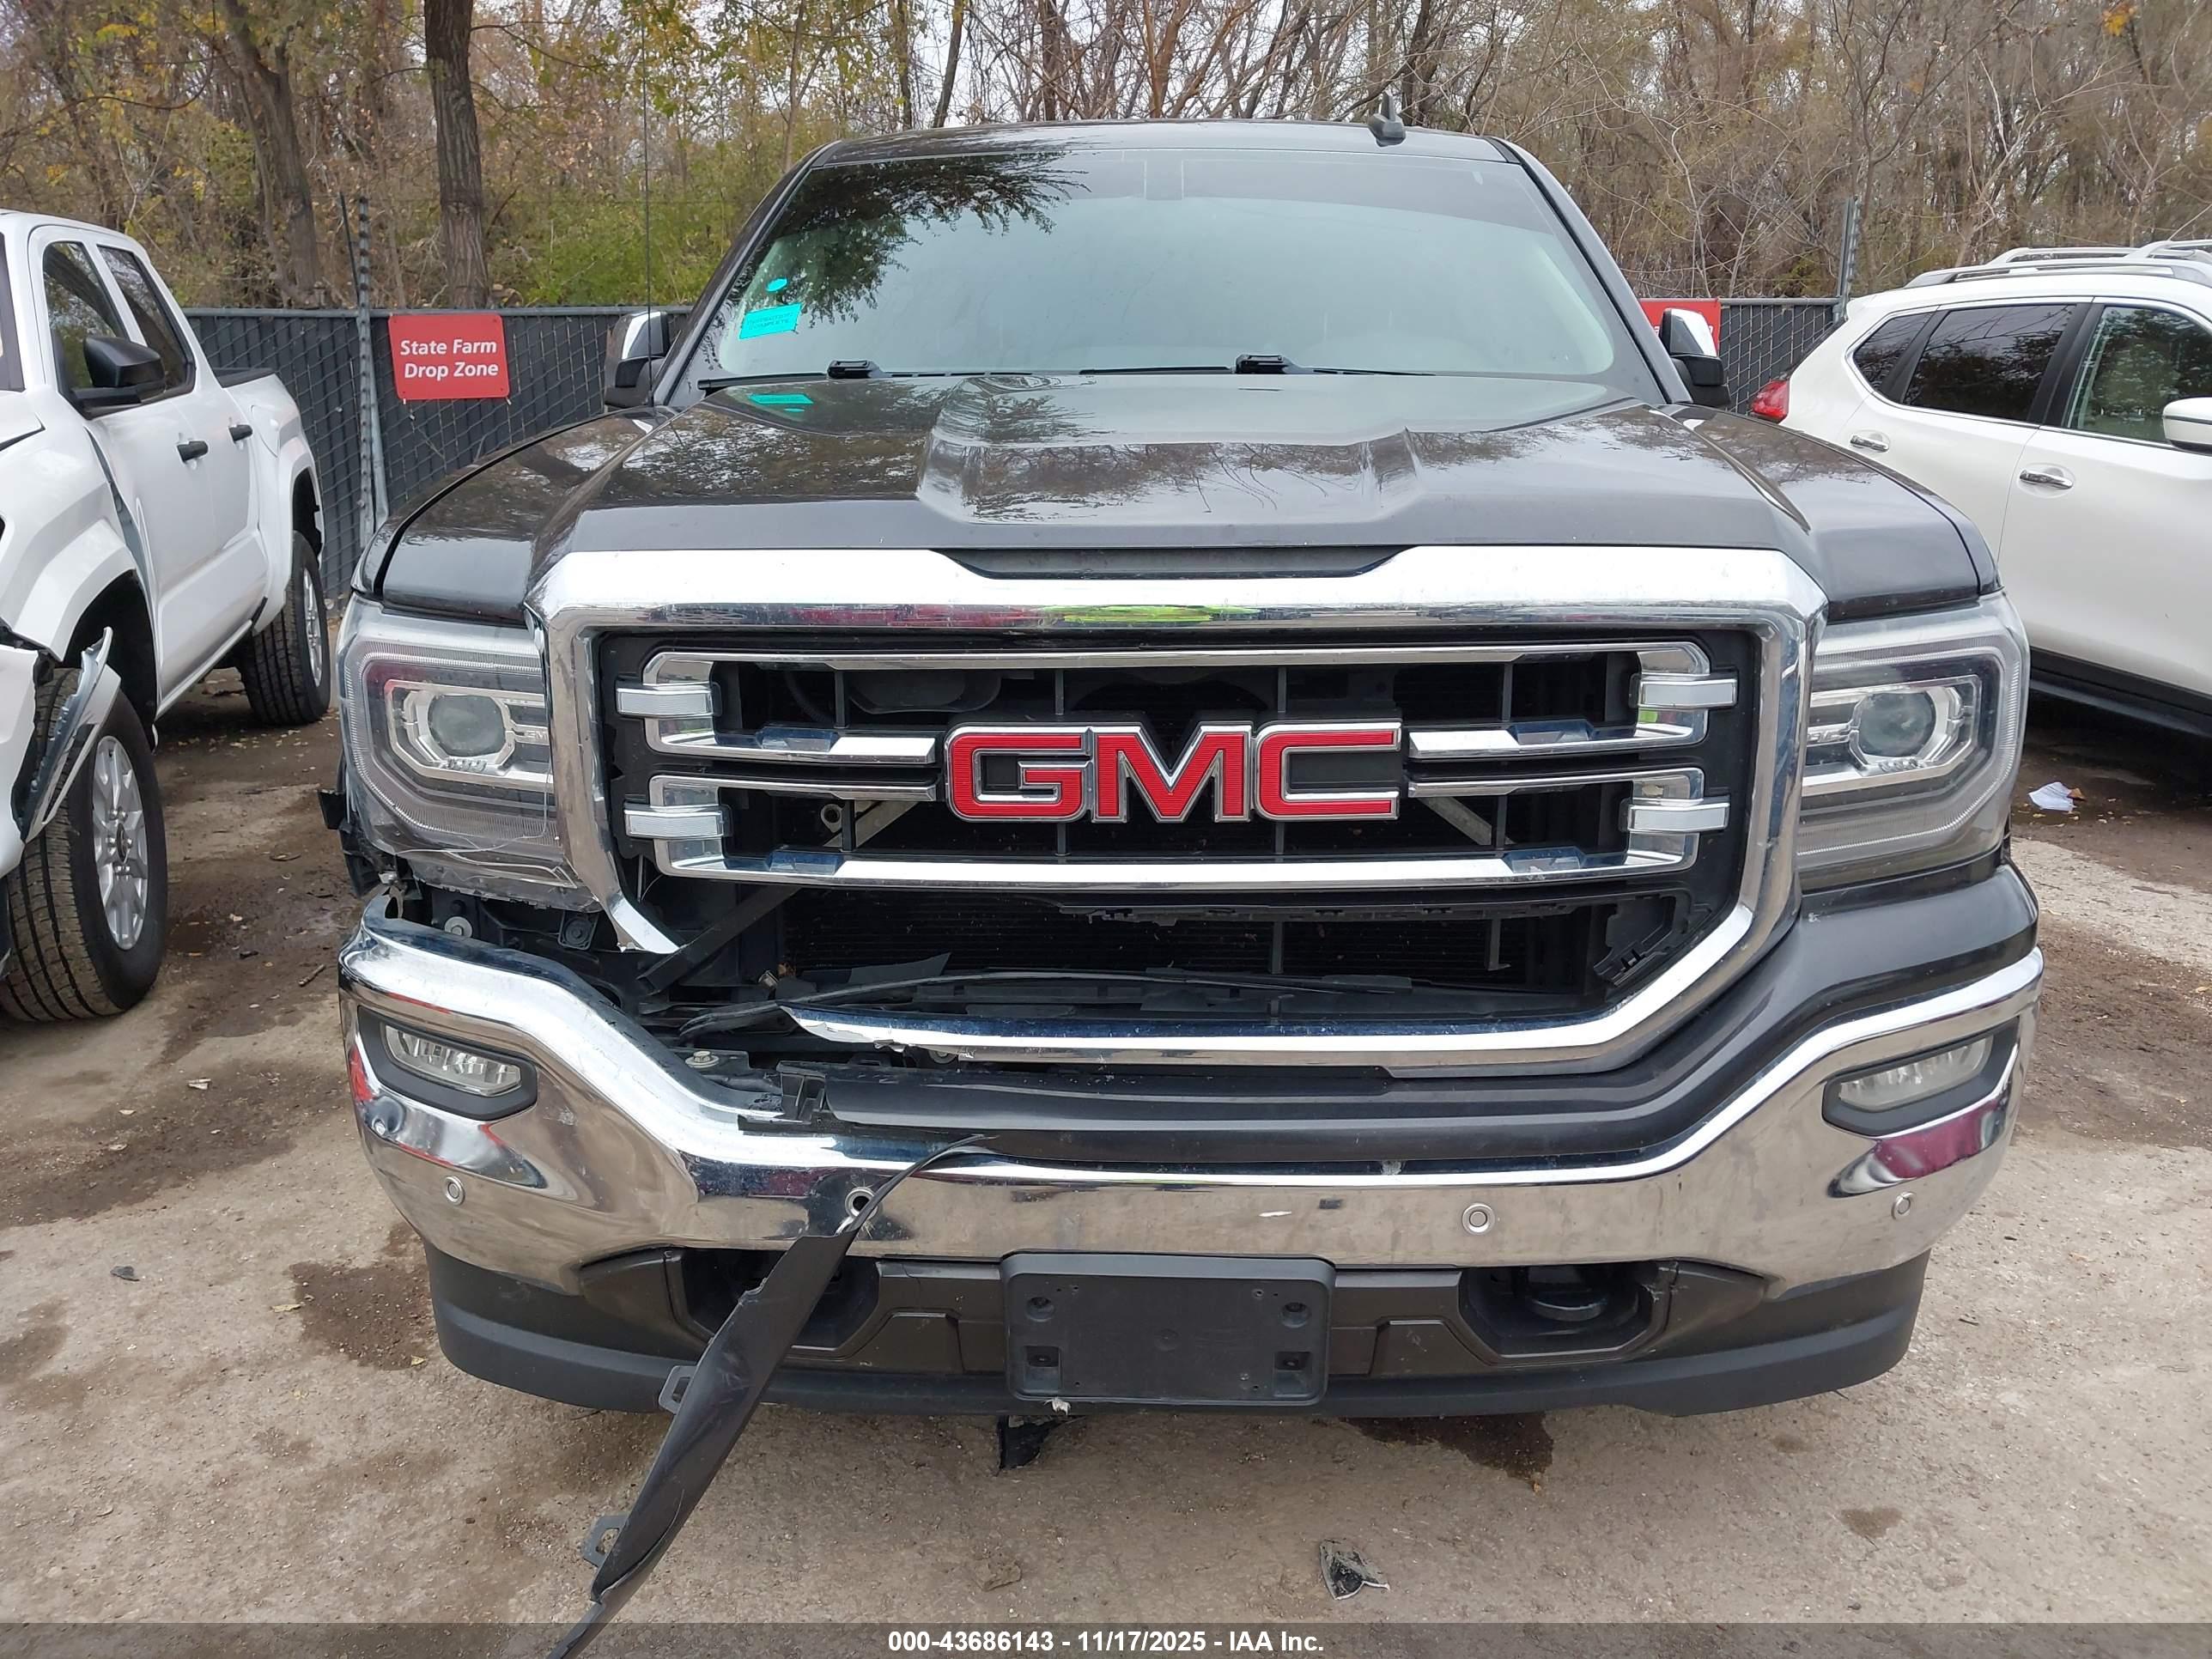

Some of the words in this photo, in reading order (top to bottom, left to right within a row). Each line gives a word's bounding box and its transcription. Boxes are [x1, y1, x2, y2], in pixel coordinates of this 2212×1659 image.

[400, 340, 447, 356] State
[453, 339, 497, 354] Farm
[404, 362, 448, 381] Drop
[453, 362, 499, 377] Zone
[945, 721, 1402, 823] GMC
